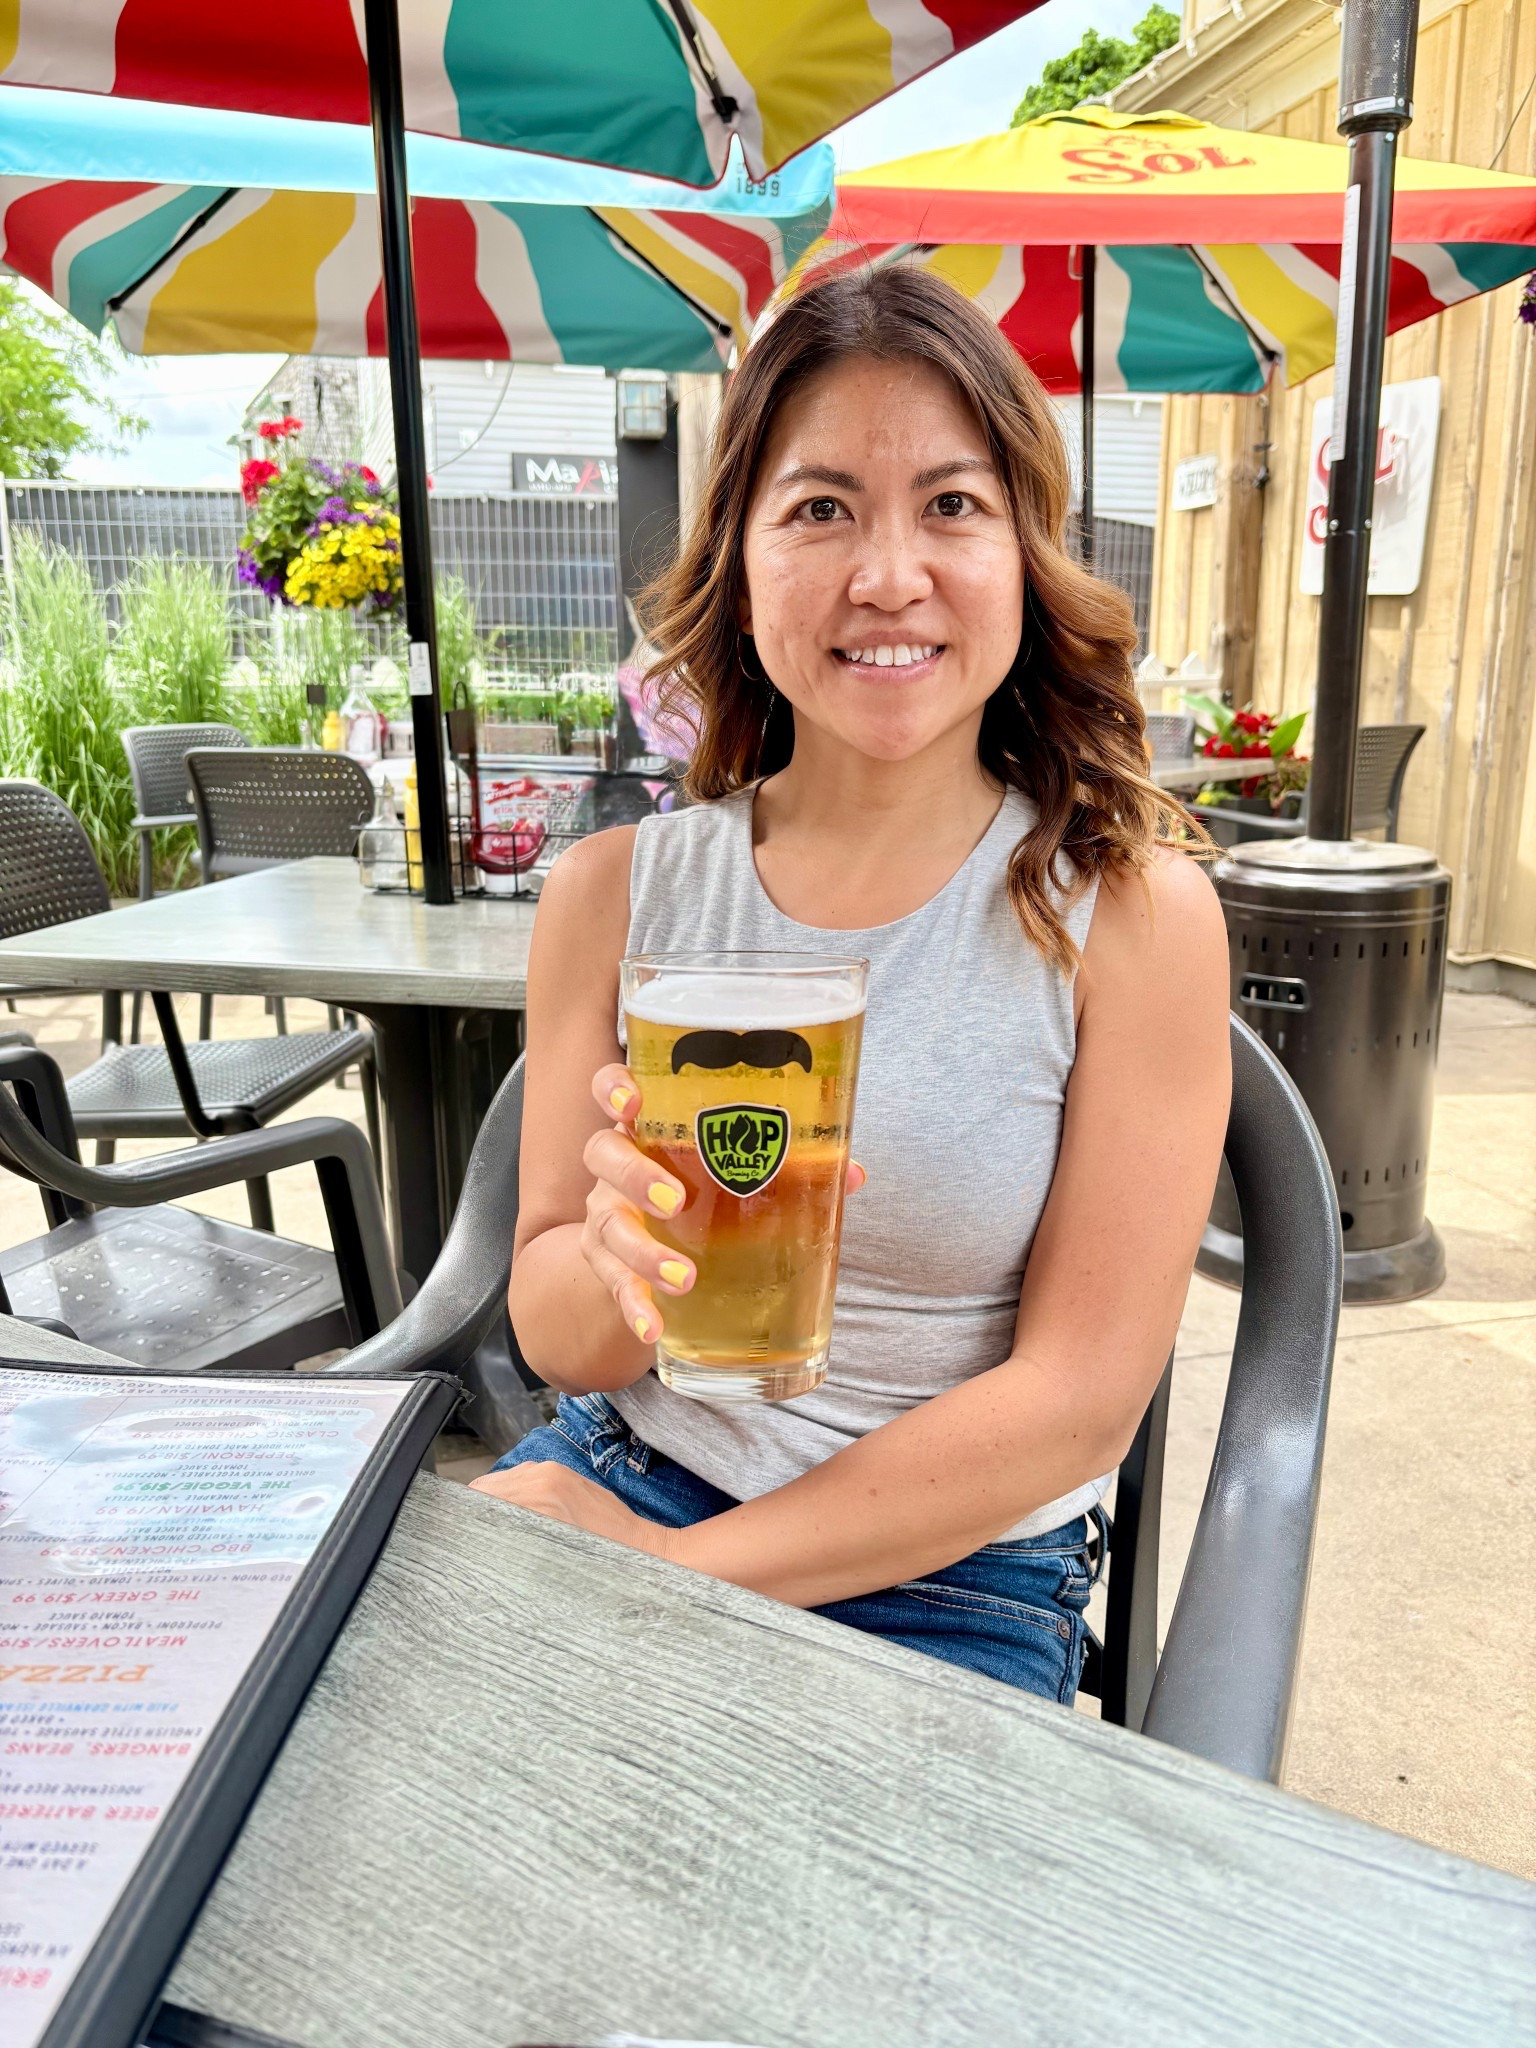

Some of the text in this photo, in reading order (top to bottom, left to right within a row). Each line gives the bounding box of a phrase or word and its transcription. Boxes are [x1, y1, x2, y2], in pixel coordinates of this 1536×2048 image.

[737, 176, 780, 197] 1899
[714, 1154, 772, 1171] VALLEY
[266, 1430, 339, 1438] CLASSIC
[258, 1480, 292, 1490] THE
[184, 1493, 240, 1501] PINEAPPLE
[250, 1492, 273, 1501] HAM
[156, 1525, 189, 1533] SAUCE
[145, 1534, 185, 1542] ONIONS
[246, 1532, 294, 1541] CHICKEN
[210, 1543, 253, 1552] BBQ
[36, 1577, 76, 1586] OLIVES
[88, 1576, 133, 1585] TOMATO
[145, 1575, 189, 1583] CHEESE
[192, 1575, 219, 1583] FETA
[232, 1574, 268, 1582] ONION
[270, 1574, 292, 1582] RED
[165, 1590, 201, 1601] THE
[48, 1611, 136, 1621] TOMATO SAUCE
[34, 1623, 89, 1632] SAUSAGE
[102, 1621, 143, 1631] BACON
[157, 1620, 223, 1630] PEPPERONI
[35, 1727, 99, 1737] SAUSAGE
[100, 1727, 142, 1737] STYLE
[145, 1727, 203, 1737] ENGLISH
[3, 1742, 75, 1756] BEANS
[104, 1805, 160, 1820] BEER
